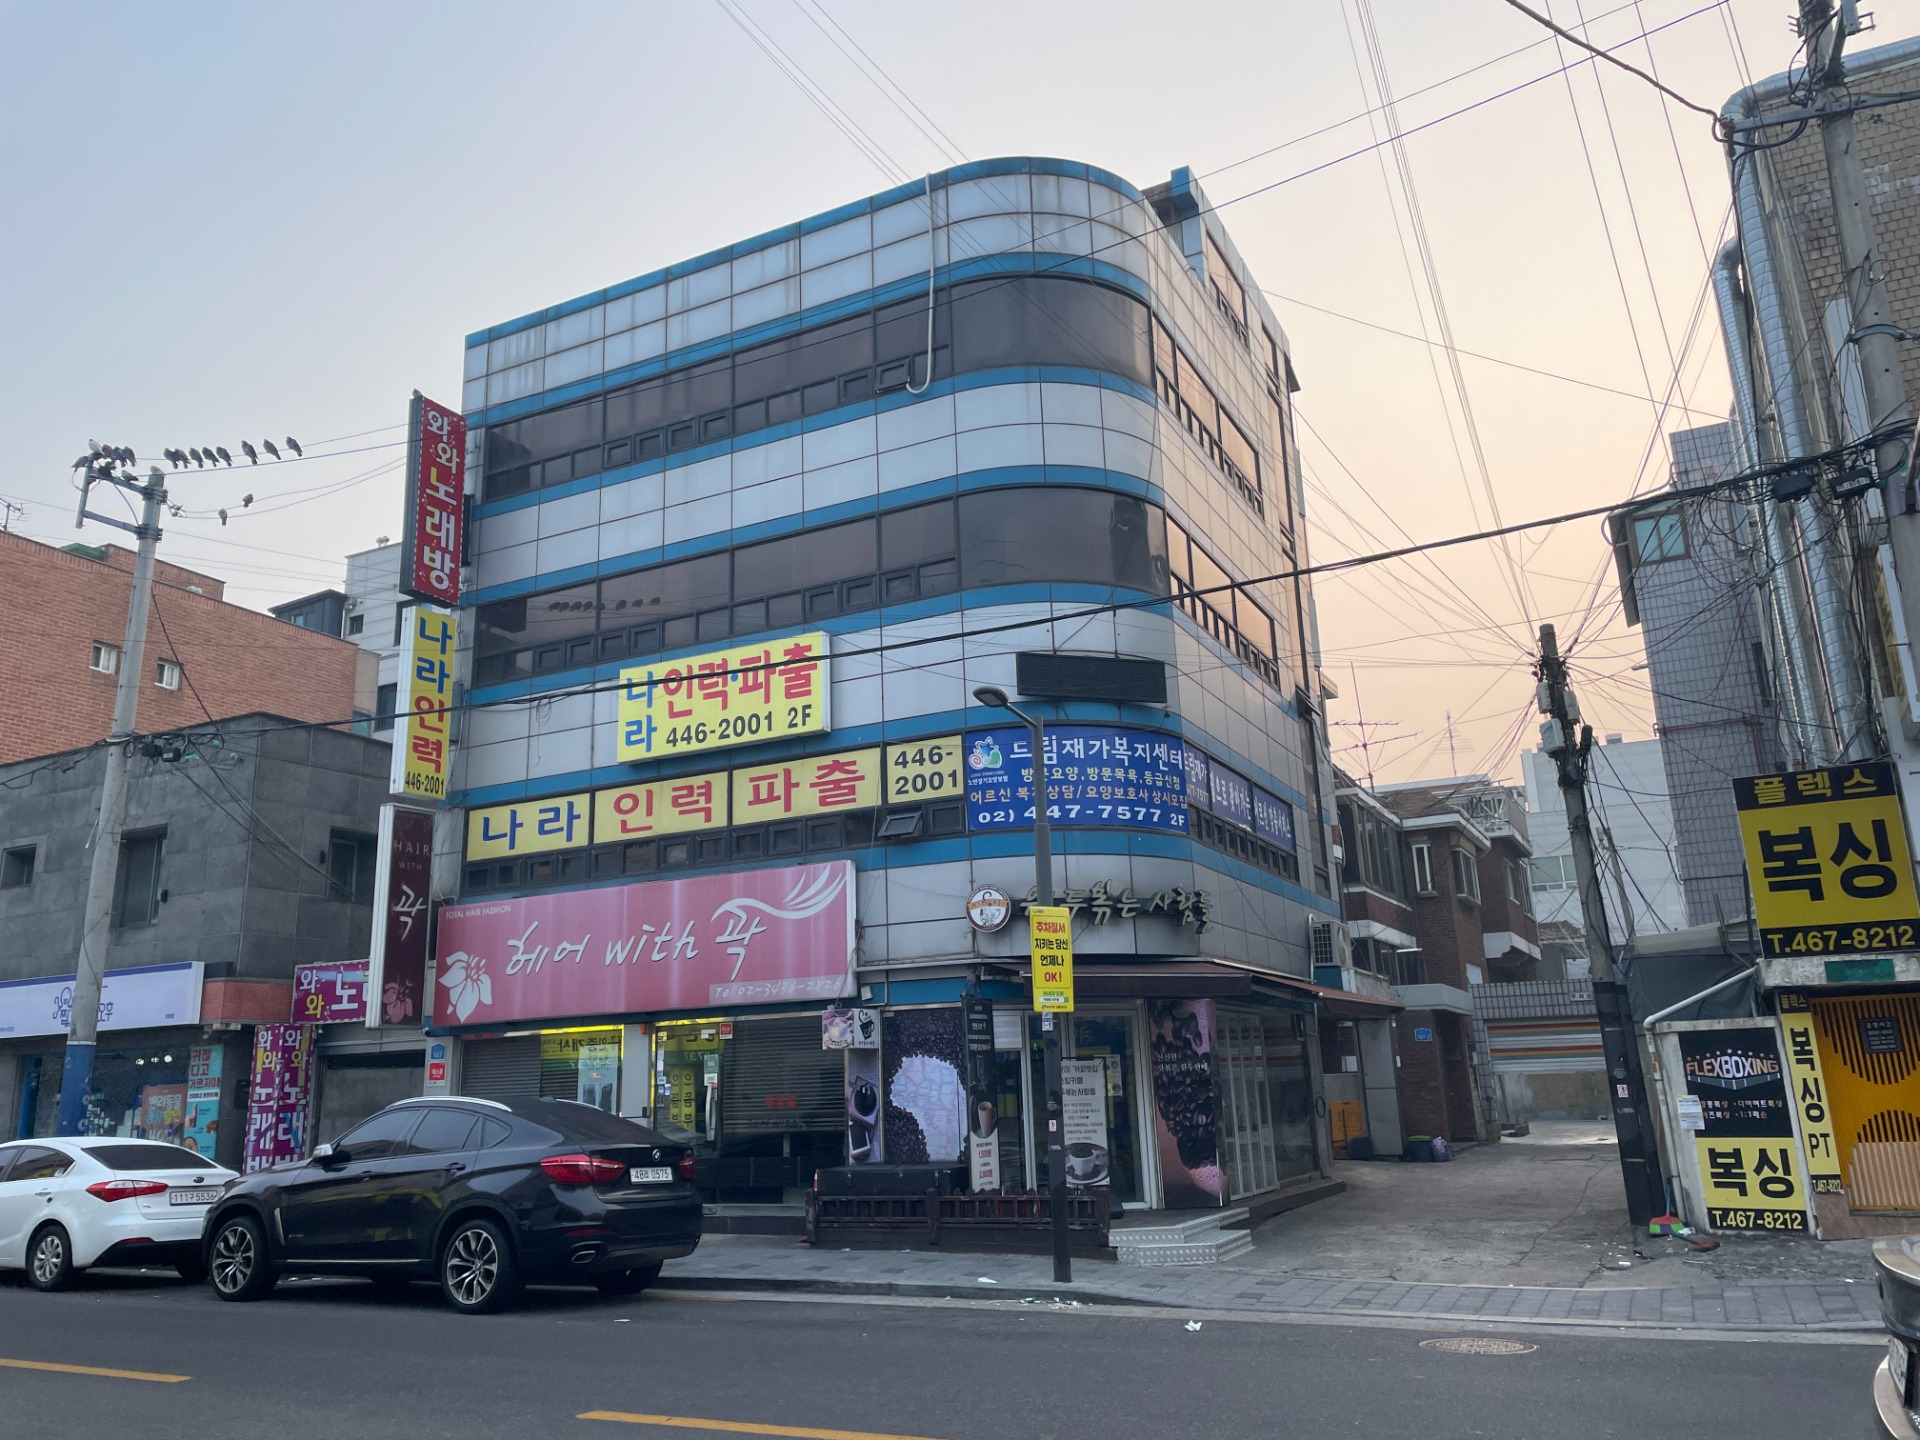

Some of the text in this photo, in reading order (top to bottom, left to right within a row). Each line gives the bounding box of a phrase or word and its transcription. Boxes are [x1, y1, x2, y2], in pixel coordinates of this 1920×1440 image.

[425, 408, 460, 591] 와와노래방
[666, 703, 812, 748] 446-2001 2F
[1010, 734, 1183, 771] 드림재가복지센터
[404, 769, 446, 797] 446-2001
[895, 768, 958, 796] 2001
[1753, 768, 1878, 805] 플렉스
[482, 760, 866, 850] 나라 인력 파출
[970, 787, 1011, 806] 어르신
[1152, 790, 1188, 810] 상시모집
[978, 804, 1185, 827] 02) 447-7577 2F
[393, 840, 430, 856] HAIR
[398, 861, 423, 871] WITH
[1758, 819, 1898, 902] 복싱
[446, 904, 512, 920] TOTAL HAIR FASHION
[1149, 886, 1214, 935] 사람들
[1036, 921, 1066, 934] 주차질서
[505, 920, 591, 975] 헤어
[606, 919, 699, 967] with
[1035, 938, 1068, 951] 지키는 당신
[1767, 925, 1916, 954] T.467-8212
[1040, 955, 1065, 967] 언제나
[738, 976, 843, 998] 02-3436-2826
[1781, 994, 1807, 1009] 플렉스
[1157, 1053, 1177, 1062] 신선한
[1686, 1055, 1780, 1078] FLEXBOXING
[191, 1063, 209, 1077] 다고
[276, 1028, 308, 1167] 와와노래
[1808, 1133, 1831, 1159] PT
[651, 1169, 670, 1180] 0575
[1707, 1148, 1796, 1199] 복싱
[1712, 1210, 1803, 1231] T.467-8212
